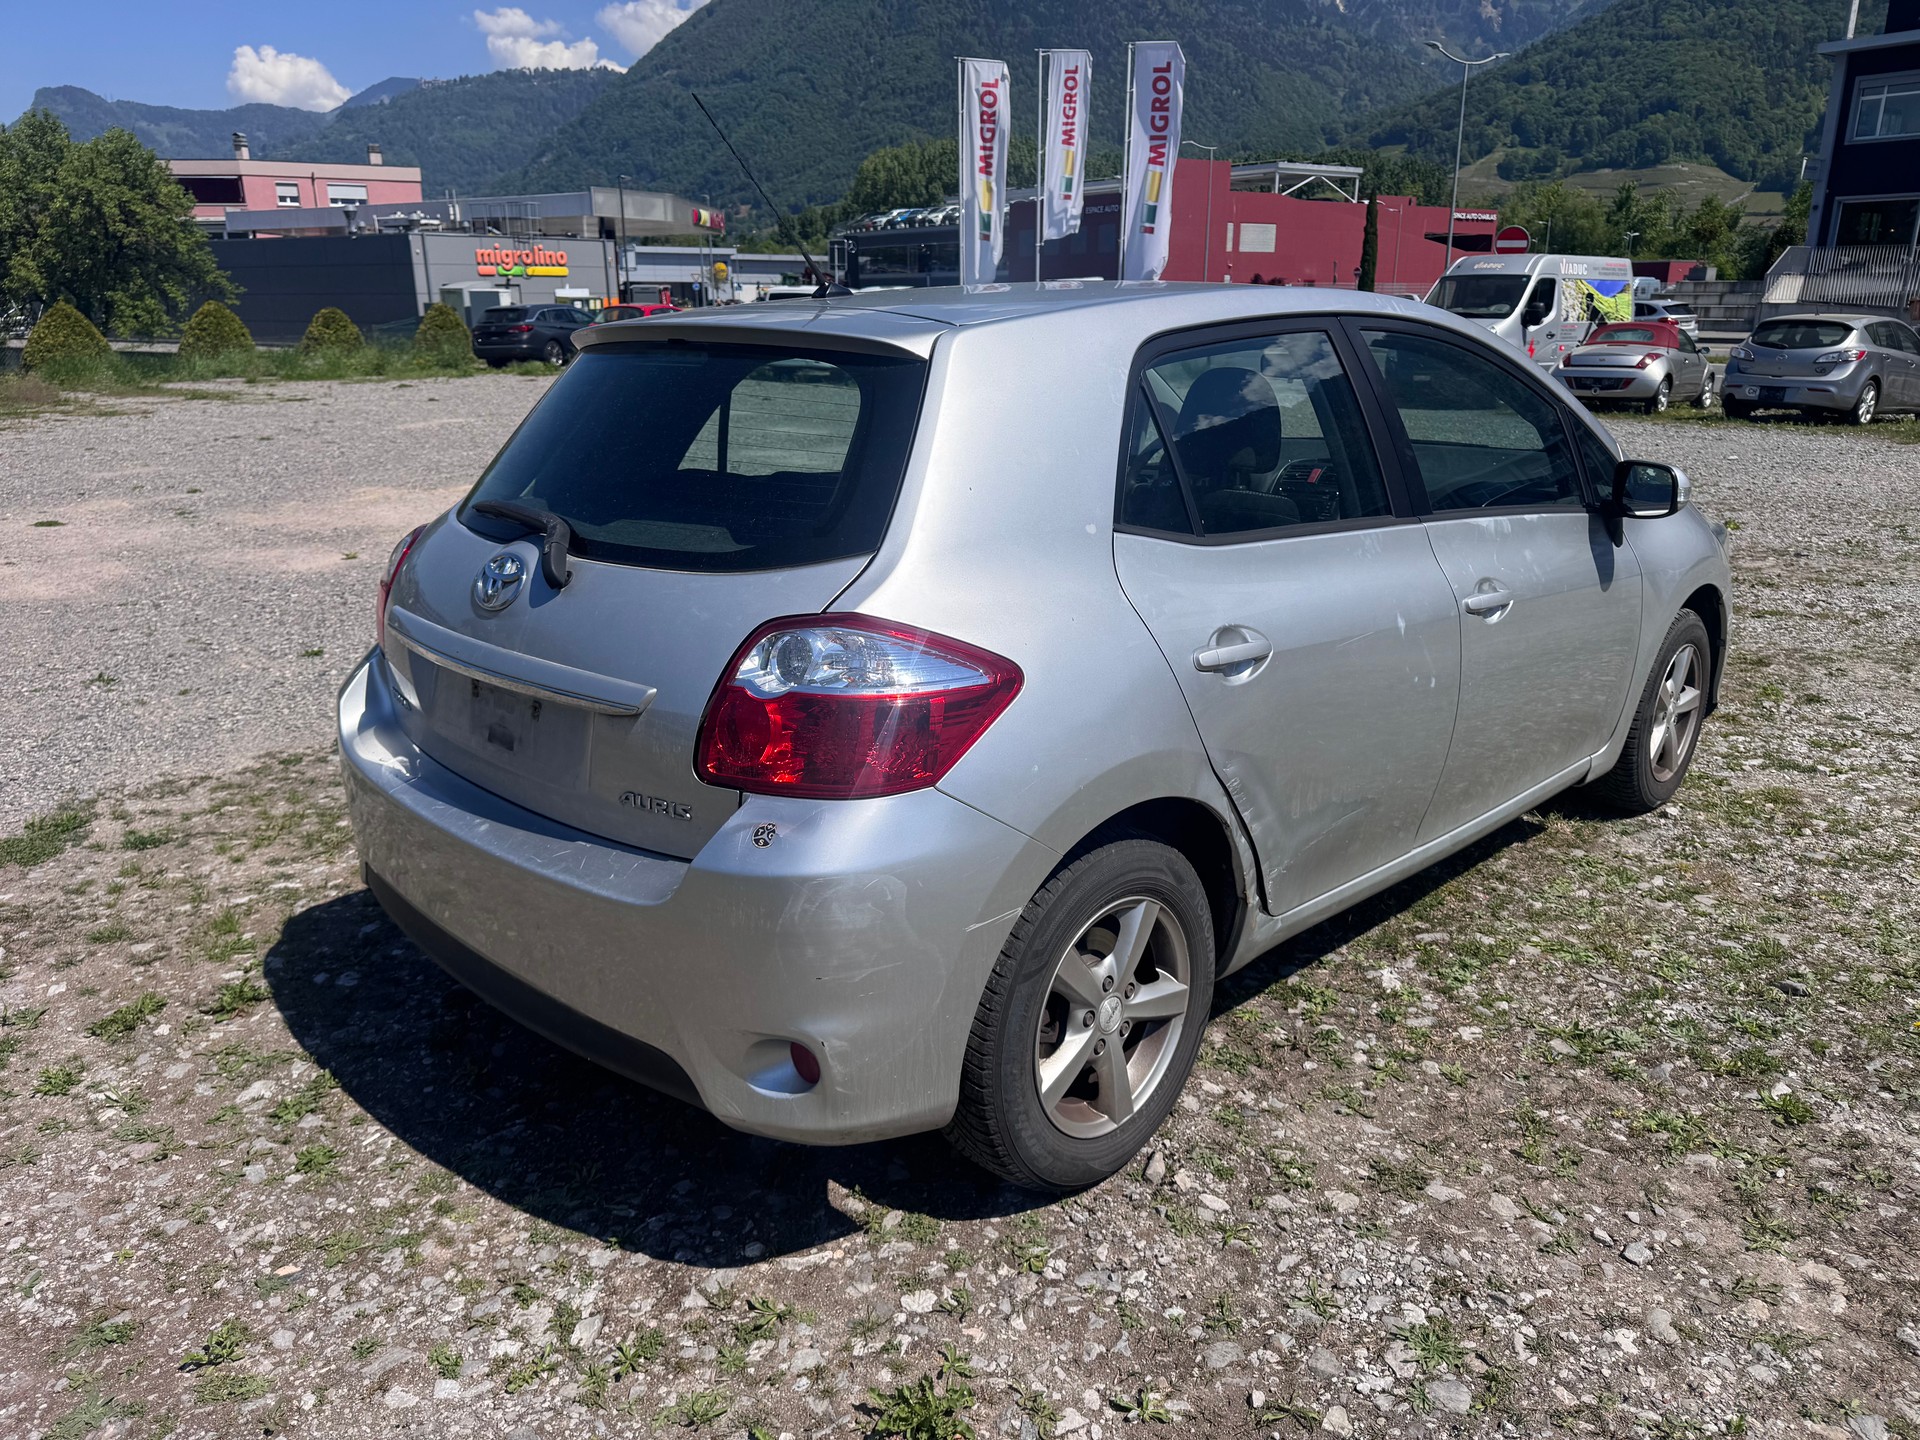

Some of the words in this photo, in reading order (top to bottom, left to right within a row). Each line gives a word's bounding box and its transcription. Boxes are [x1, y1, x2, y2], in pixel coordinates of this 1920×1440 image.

[979, 78, 999, 176] MIGROL
[1062, 65, 1079, 147] MIGROL
[1148, 61, 1172, 167] MIGROL
[476, 243, 568, 270] migrolino
[1560, 258, 1588, 275] VIADUC
[619, 791, 692, 821] AURIS
